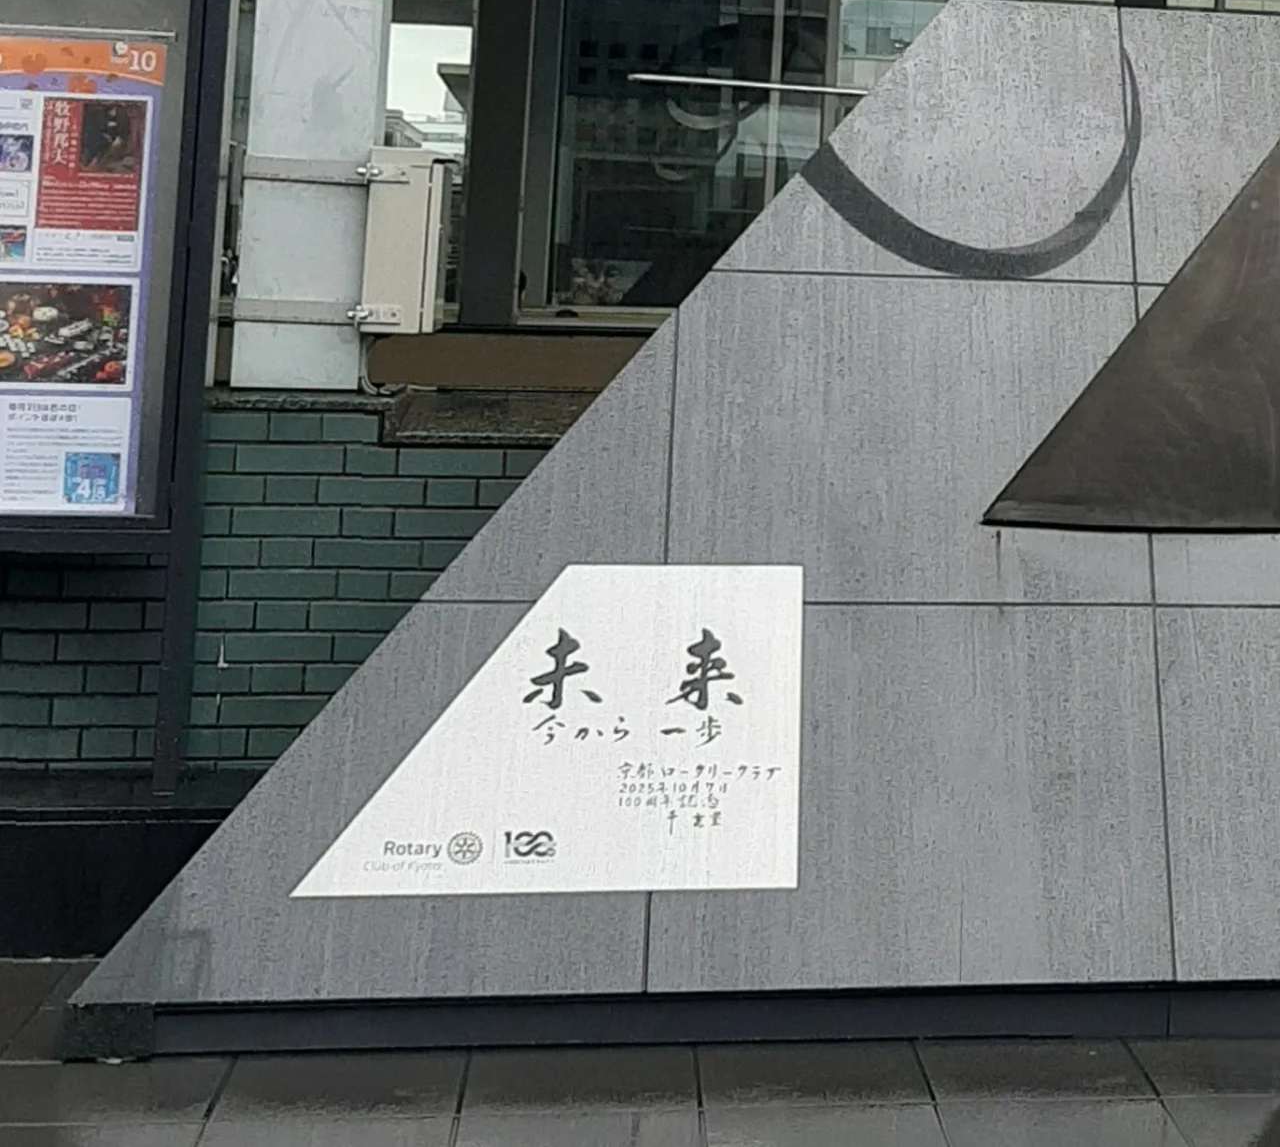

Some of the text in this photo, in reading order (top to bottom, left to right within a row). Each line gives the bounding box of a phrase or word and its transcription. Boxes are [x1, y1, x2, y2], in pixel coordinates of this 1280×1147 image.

[129, 49, 158, 72] 10
[522, 626, 744, 711] 未来
[382, 840, 443, 858] Rotary
[363, 860, 390, 872] Club
